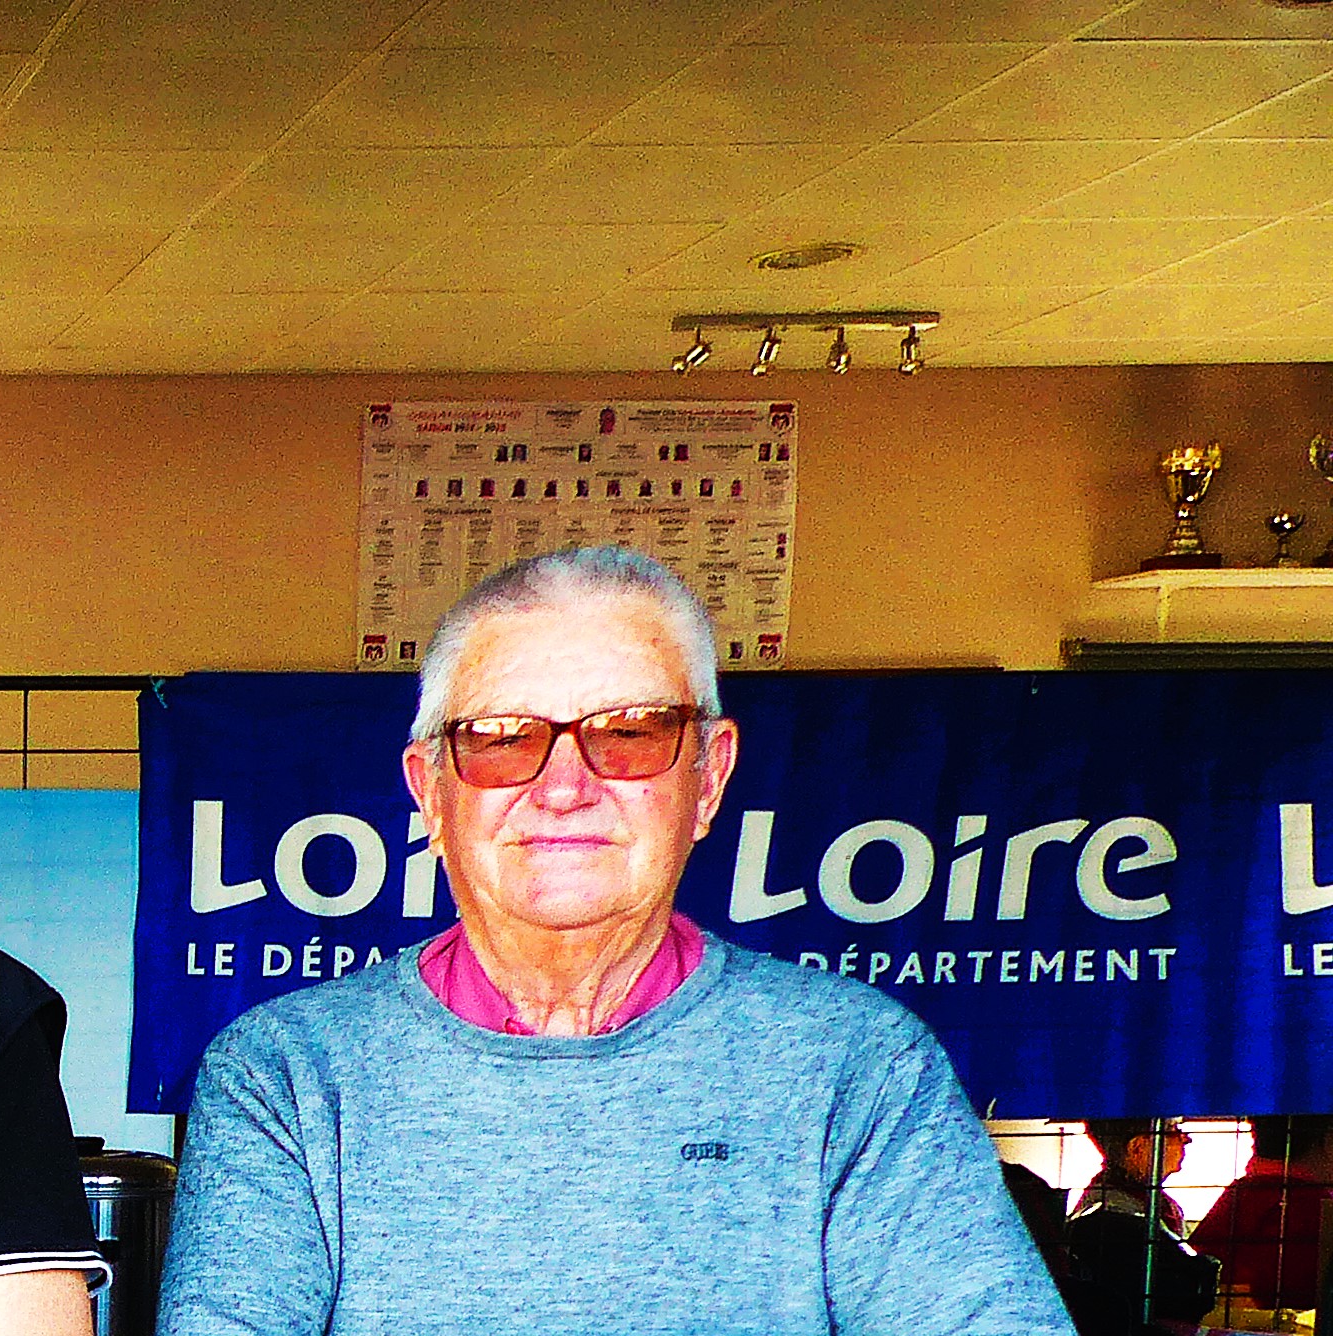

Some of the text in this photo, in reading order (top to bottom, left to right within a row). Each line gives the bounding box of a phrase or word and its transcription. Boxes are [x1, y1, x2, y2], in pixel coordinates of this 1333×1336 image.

[190, 800, 461, 918] Loi
[728, 810, 1177, 923] Loire
[187, 943, 235, 976] LE
